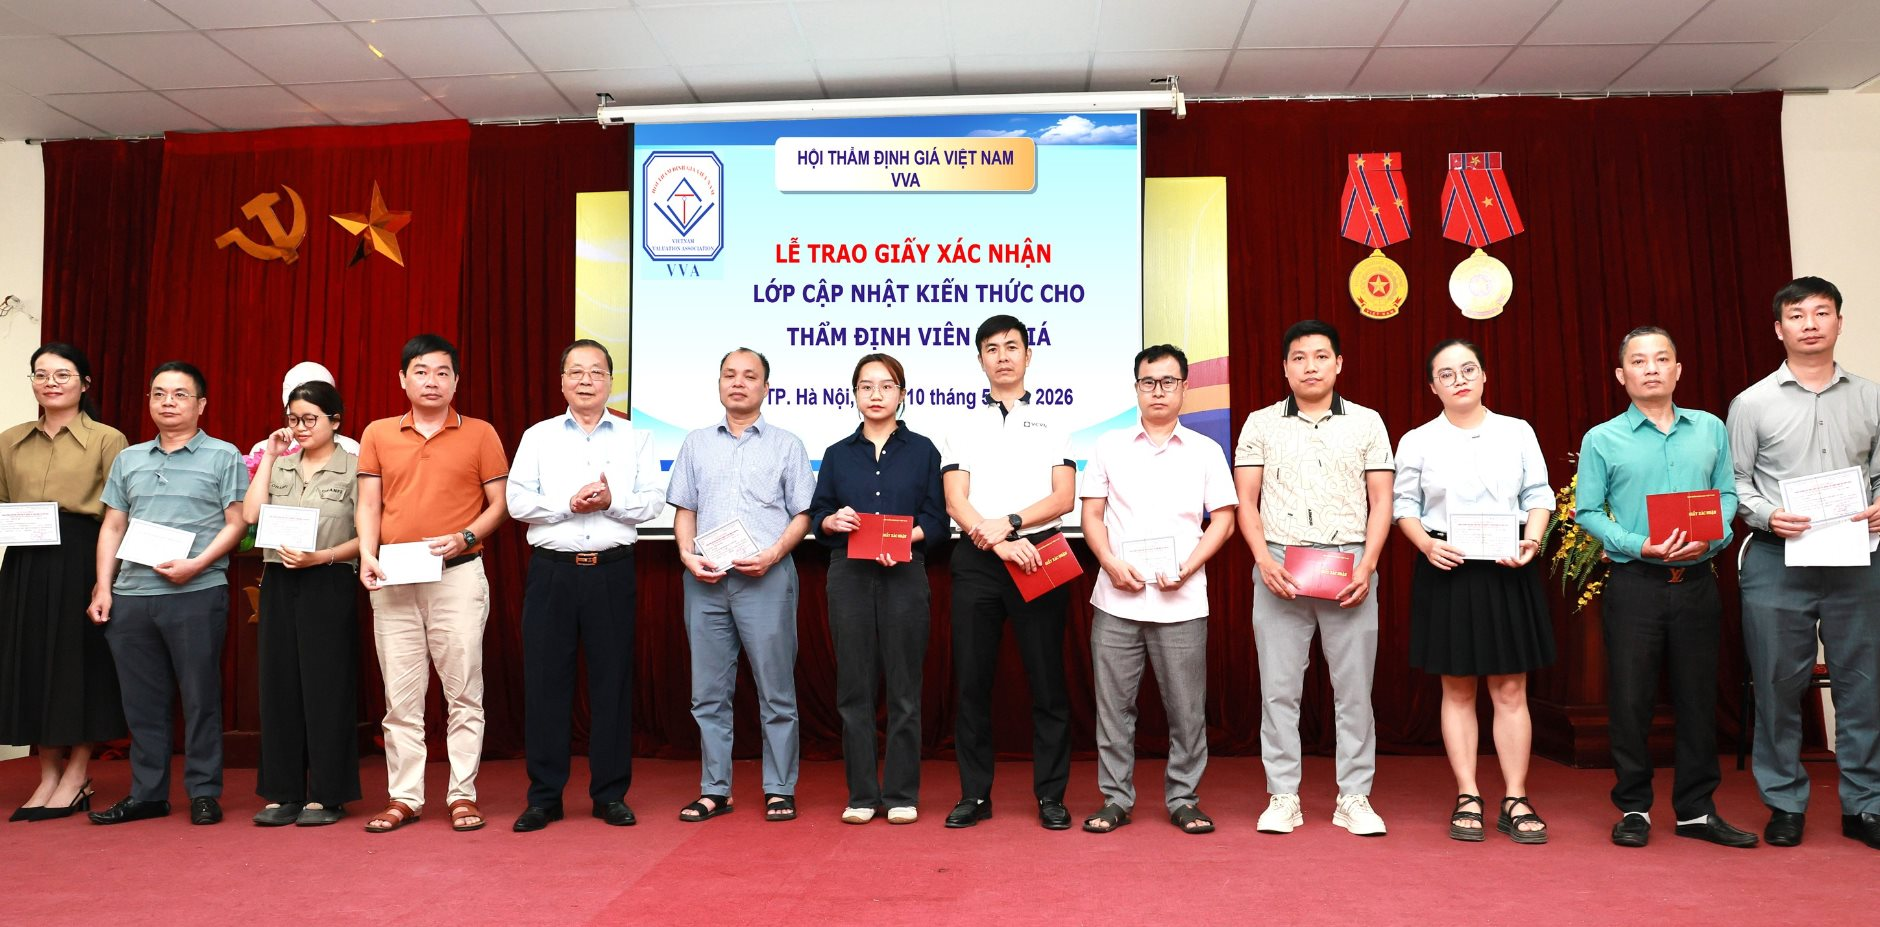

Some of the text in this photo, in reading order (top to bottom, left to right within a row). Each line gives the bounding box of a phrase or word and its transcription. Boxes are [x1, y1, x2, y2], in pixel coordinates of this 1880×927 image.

[798, 148, 823, 169] HỘI
[873, 150, 910, 169] ĐỊNH
[914, 147, 940, 166] GIÁ
[944, 148, 977, 169] VIỆT
[981, 150, 1014, 166] NAM
[891, 172, 921, 188] VVA
[776, 237, 1051, 268] LỄ TRAO GIẤY XÁC NHẬN
[753, 278, 1085, 307] LỚP CẬP NHẬT KIẾN THỨC CHO
[787, 321, 847, 346] THẨM
[854, 327, 911, 350] ĐỊNH
[918, 321, 970, 346] VIÊN
[767, 388, 1074, 409] TP. Hà Nội, 10 tháng 5 2026
